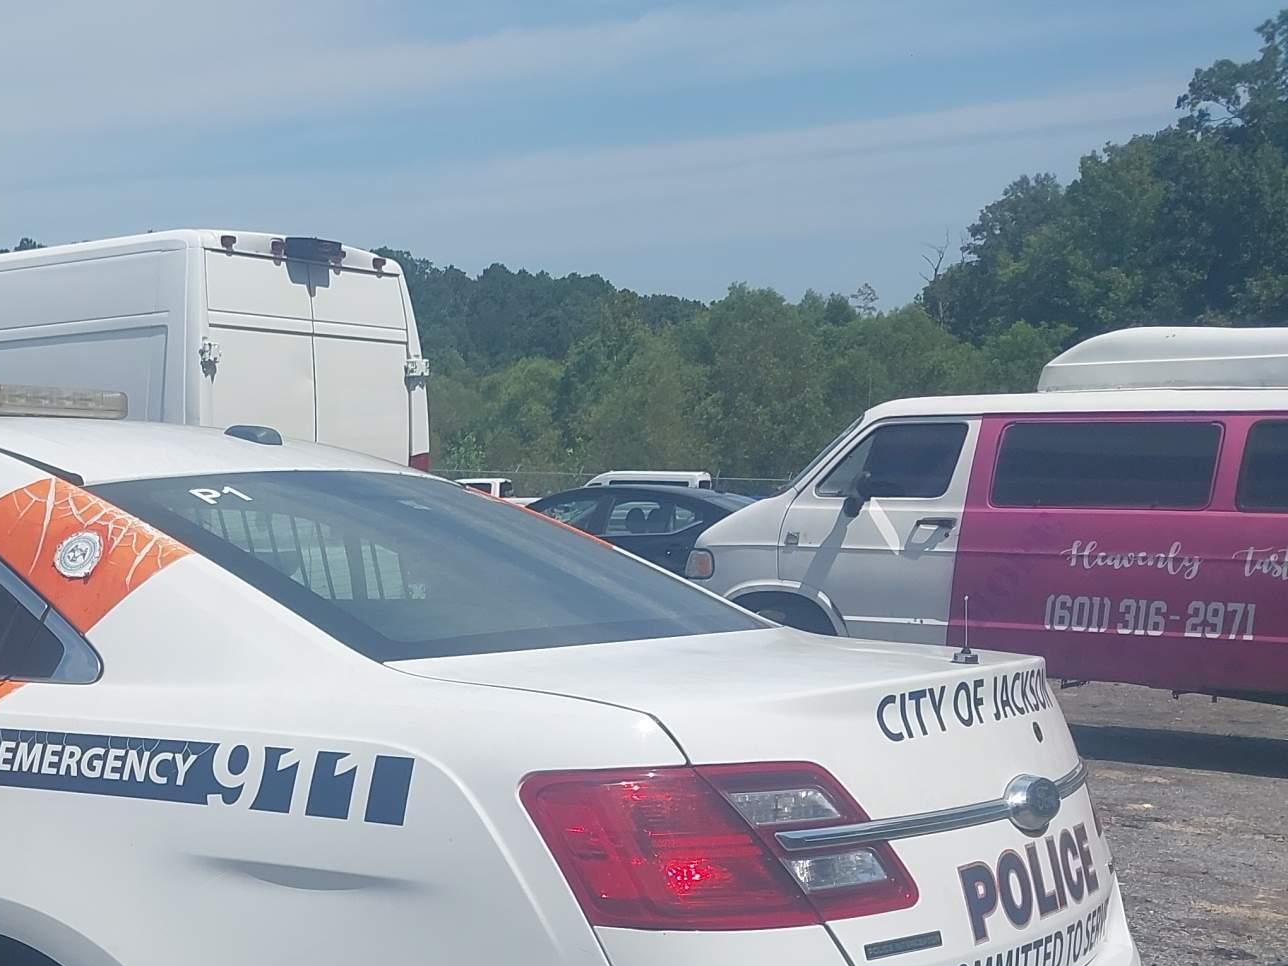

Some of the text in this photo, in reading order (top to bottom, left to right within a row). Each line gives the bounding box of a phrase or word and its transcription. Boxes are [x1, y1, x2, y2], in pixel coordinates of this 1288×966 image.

[189, 486, 253, 504] P1
[1060, 540, 1203, 579] Heavenly
[1045, 594, 1111, 632] (601)
[1184, 600, 1256, 640] 2971
[876, 668, 1053, 741] CITY OF JACKSON
[208, 742, 381, 823] 911
[957, 823, 1099, 943] POLICE
